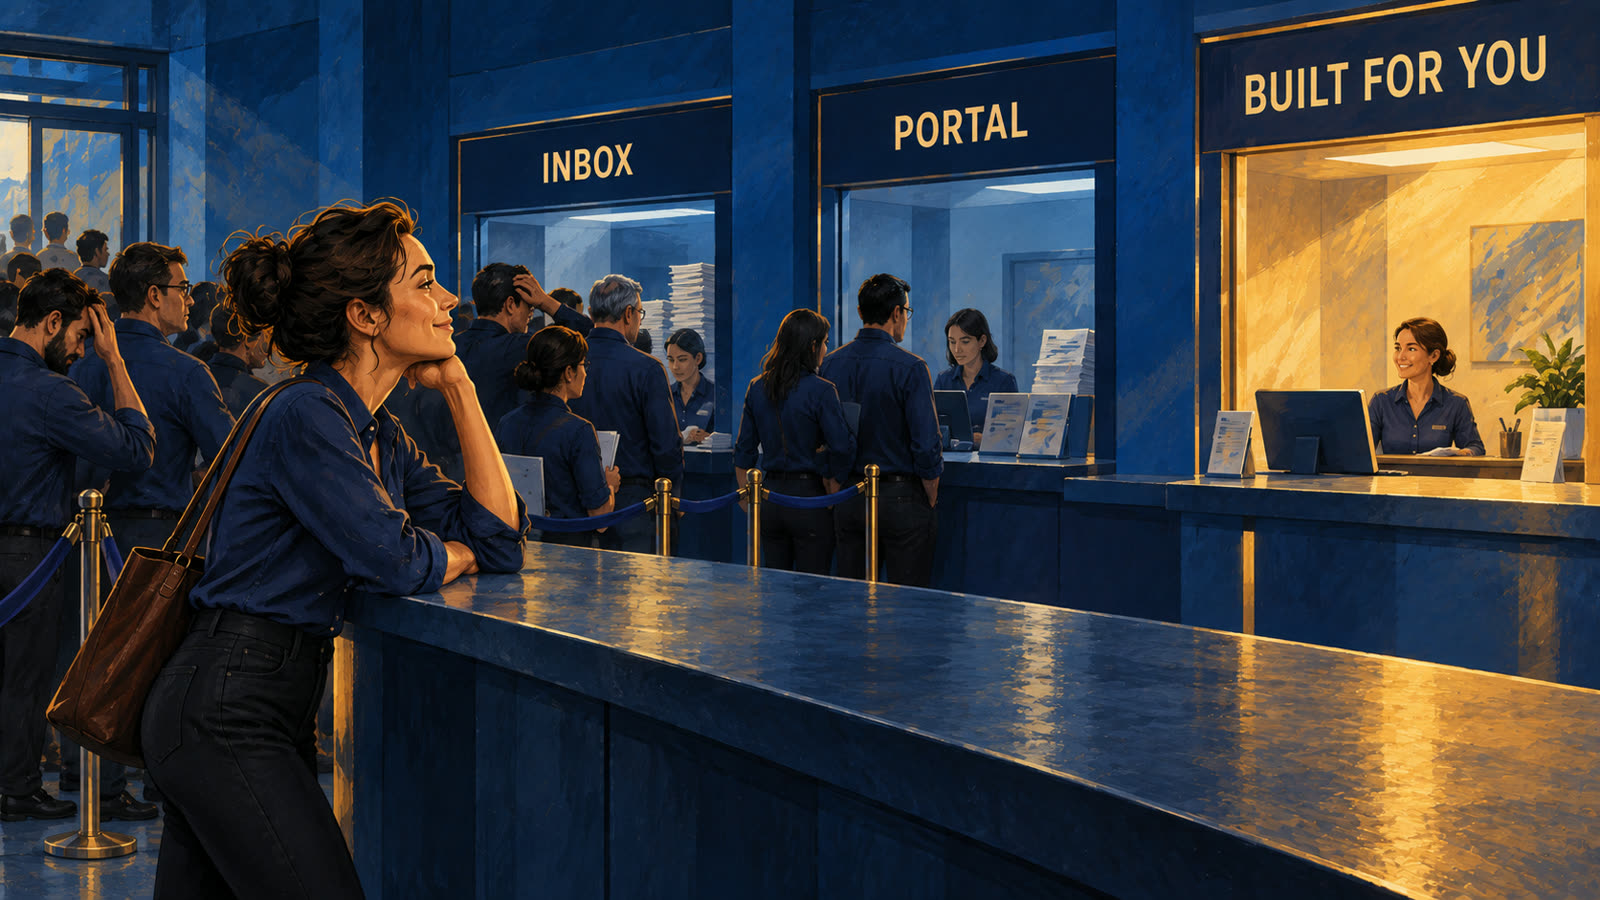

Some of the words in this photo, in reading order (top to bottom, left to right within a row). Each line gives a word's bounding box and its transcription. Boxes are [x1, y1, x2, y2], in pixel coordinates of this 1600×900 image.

[1245, 61, 1349, 116] BUILT
[1364, 50, 1444, 102] FOR
[1458, 34, 1547, 89] YOU
[894, 101, 1029, 151] PORTAL
[542, 142, 634, 184] INBOX
